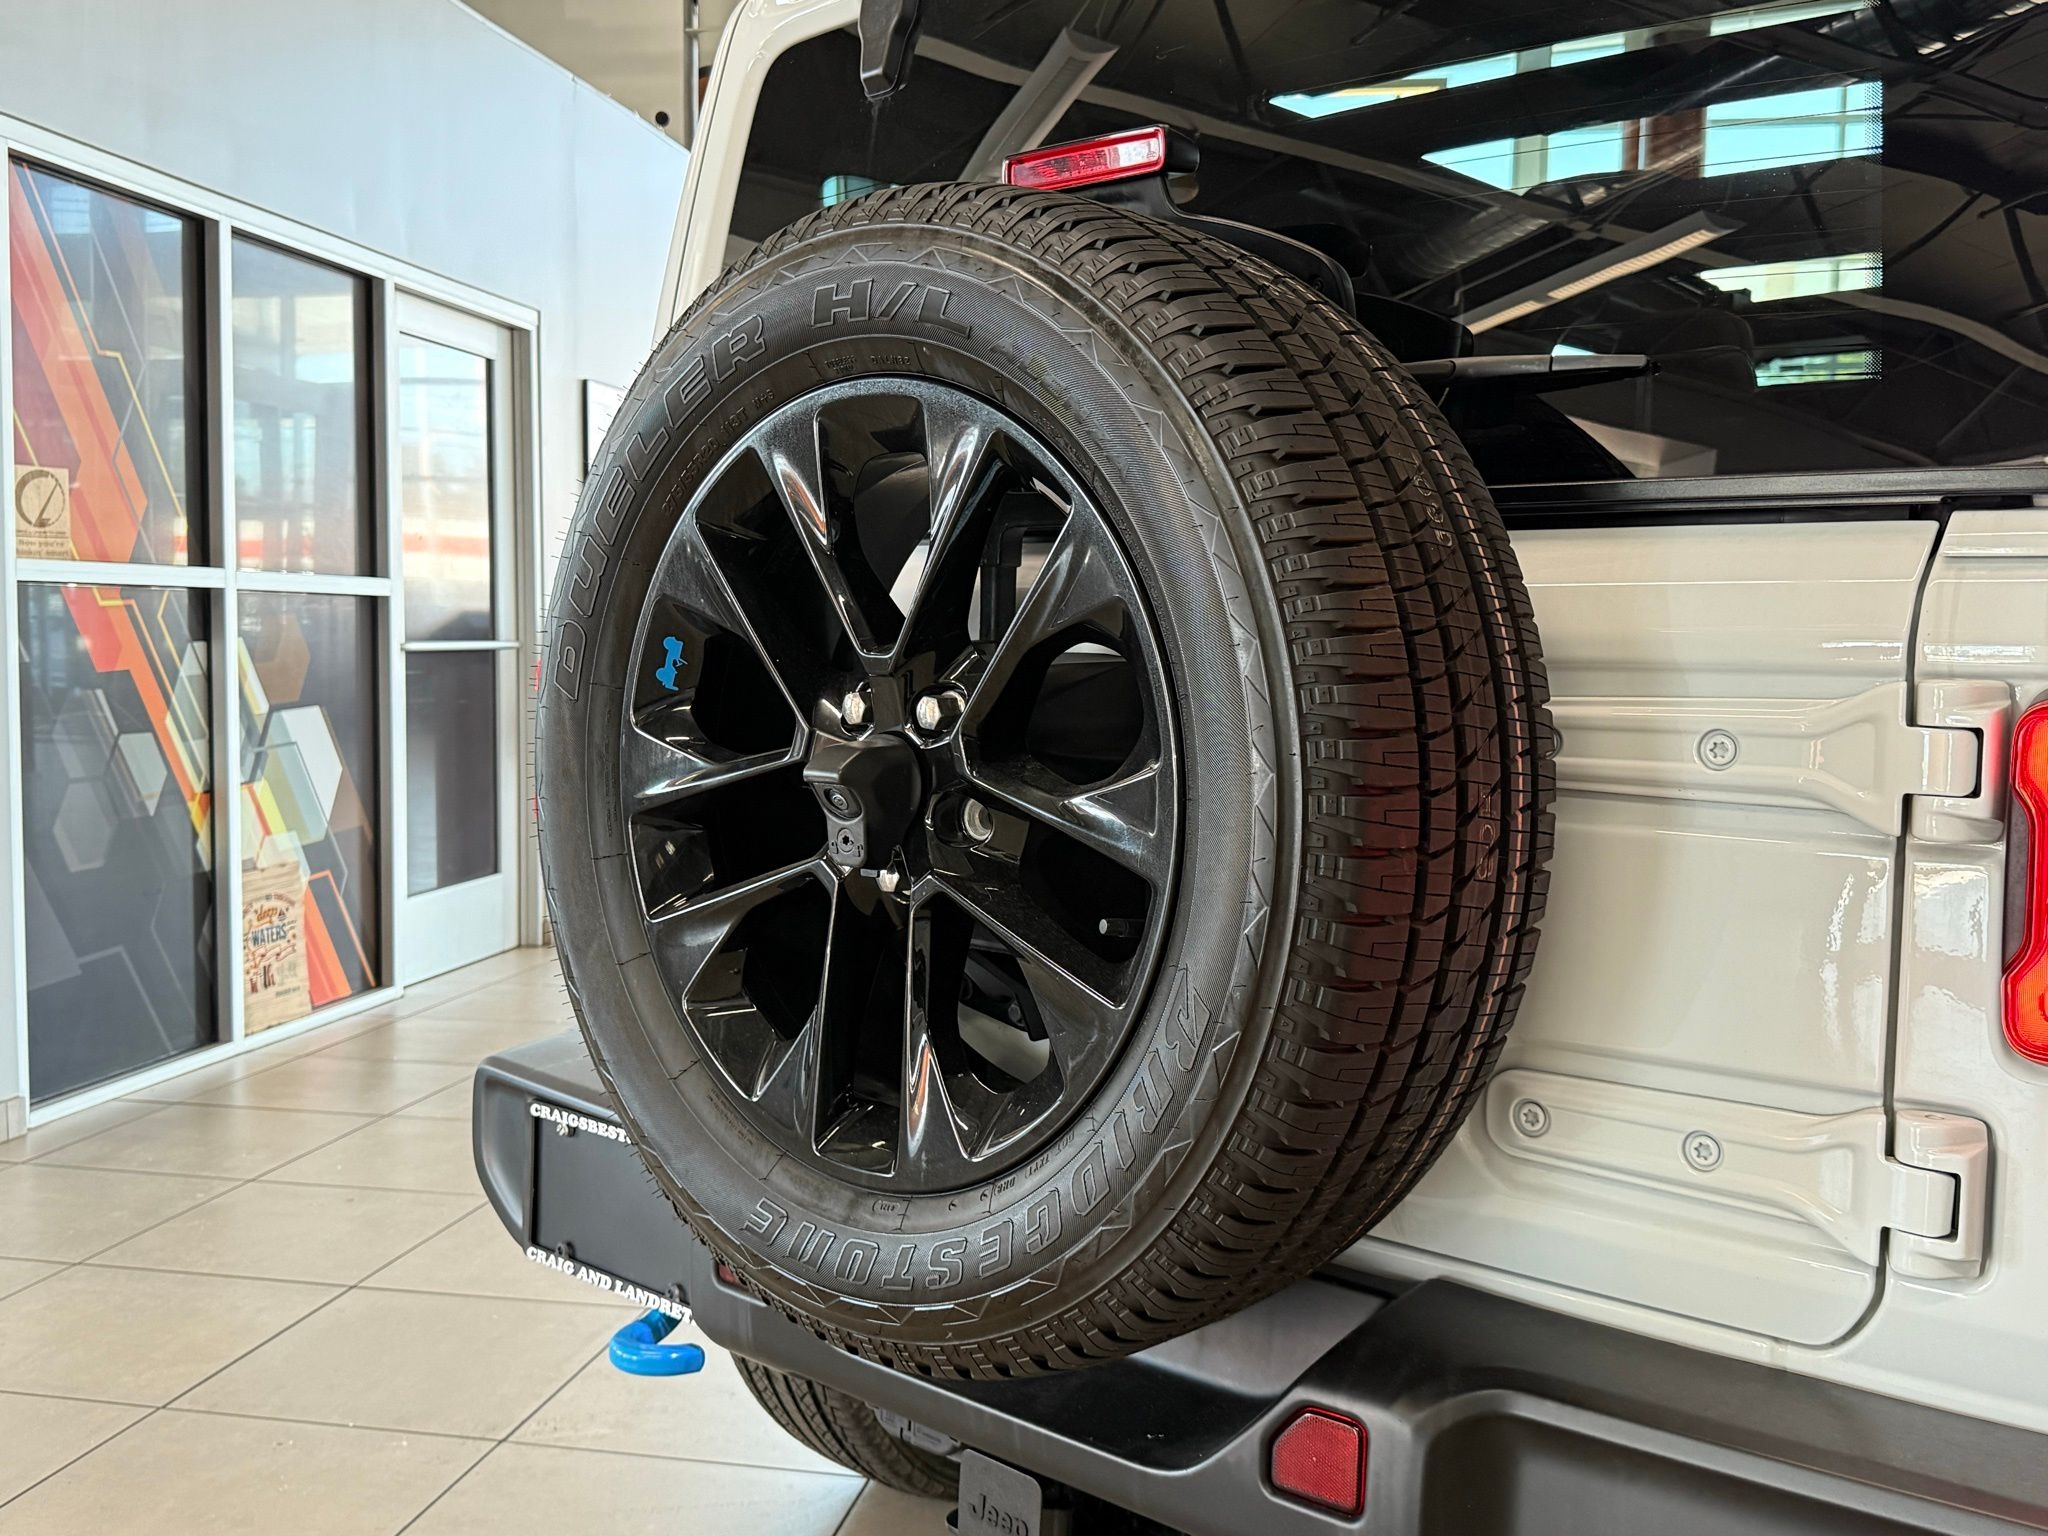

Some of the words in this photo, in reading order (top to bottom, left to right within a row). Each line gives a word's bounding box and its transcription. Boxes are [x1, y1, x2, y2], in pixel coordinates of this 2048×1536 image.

[553, 314, 766, 701] DUELER
[811, 278, 971, 339] H/L
[251, 922, 287, 947] WATERS
[740, 965, 1212, 1291] BRIDGESTONE
[526, 1246, 574, 1275] CRAIG
[576, 1266, 613, 1291] AND
